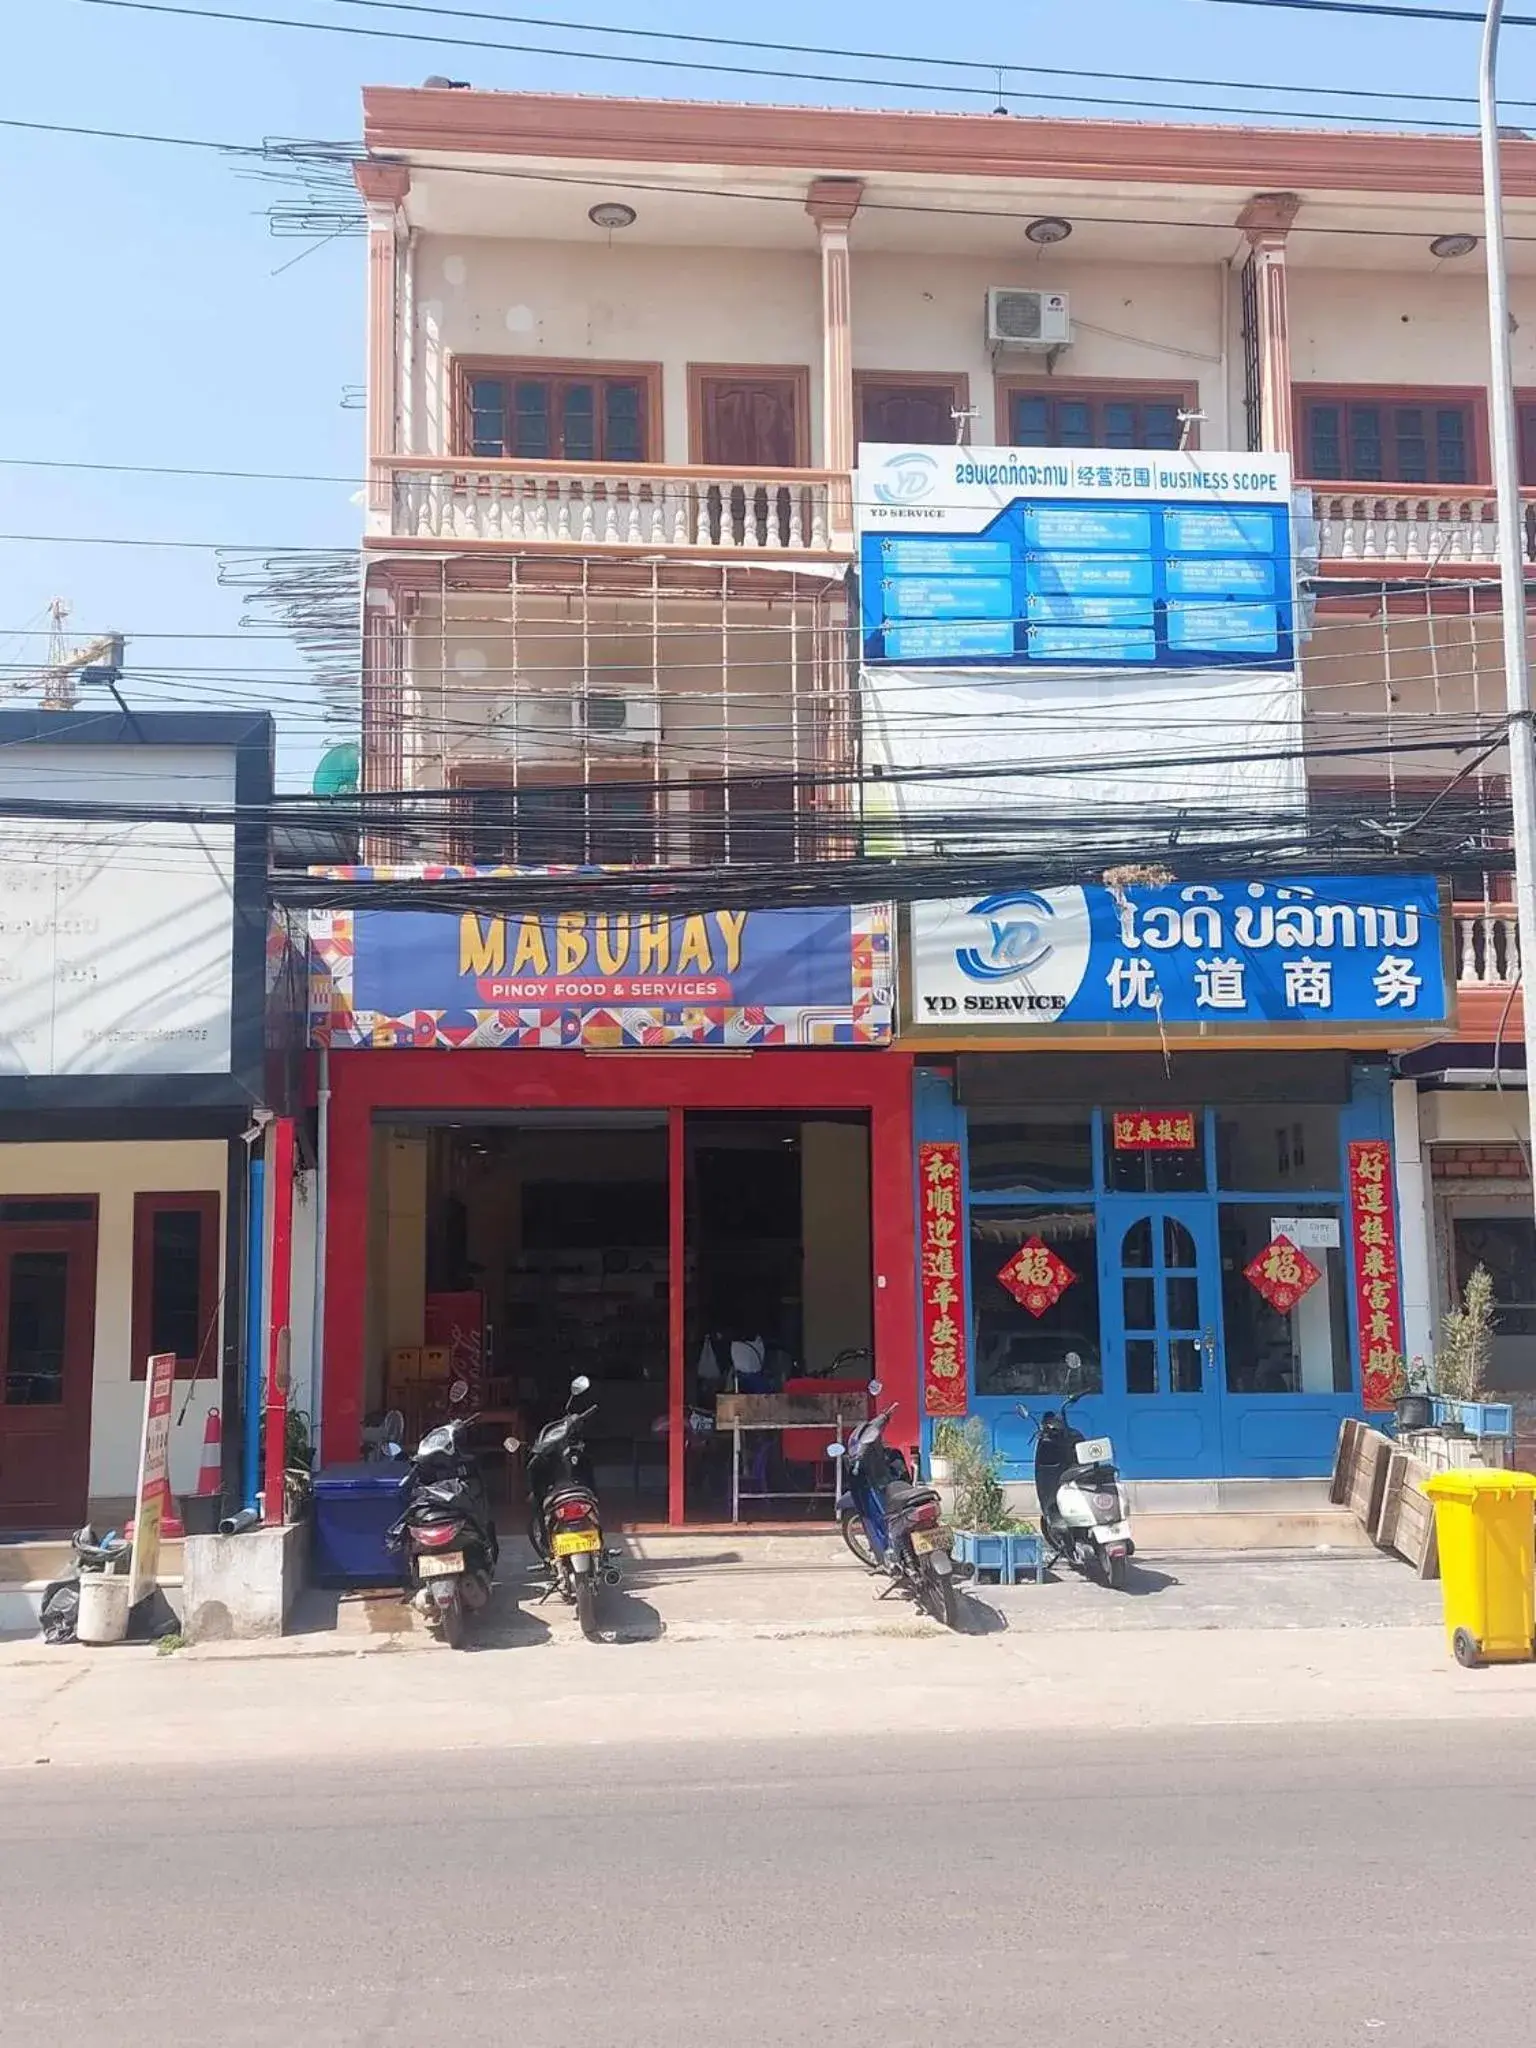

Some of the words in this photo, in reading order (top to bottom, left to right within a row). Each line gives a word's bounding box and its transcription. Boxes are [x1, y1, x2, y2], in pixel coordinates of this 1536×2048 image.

[1077, 465, 1150, 488] 经营范围
[1160, 470, 1229, 490] BUSINESS
[1232, 472, 1278, 491] SCOPE
[870, 509, 888, 518] YD
[890, 509, 945, 519] SERVICE
[1234, 882, 1418, 949] ບໍລິການ
[459, 909, 749, 977] MABUHAY
[492, 984, 548, 997] PINOY
[554, 983, 606, 996] FOOD
[613, 983, 624, 996] &
[631, 982, 717, 996] SERVICES
[1105, 954, 1422, 1010] 优道商务
[924, 995, 957, 1011] YD
[964, 995, 1066, 1011] SERVICE
[1015, 1247, 1054, 1287] 福
[1263, 1244, 1301, 1286] 福
